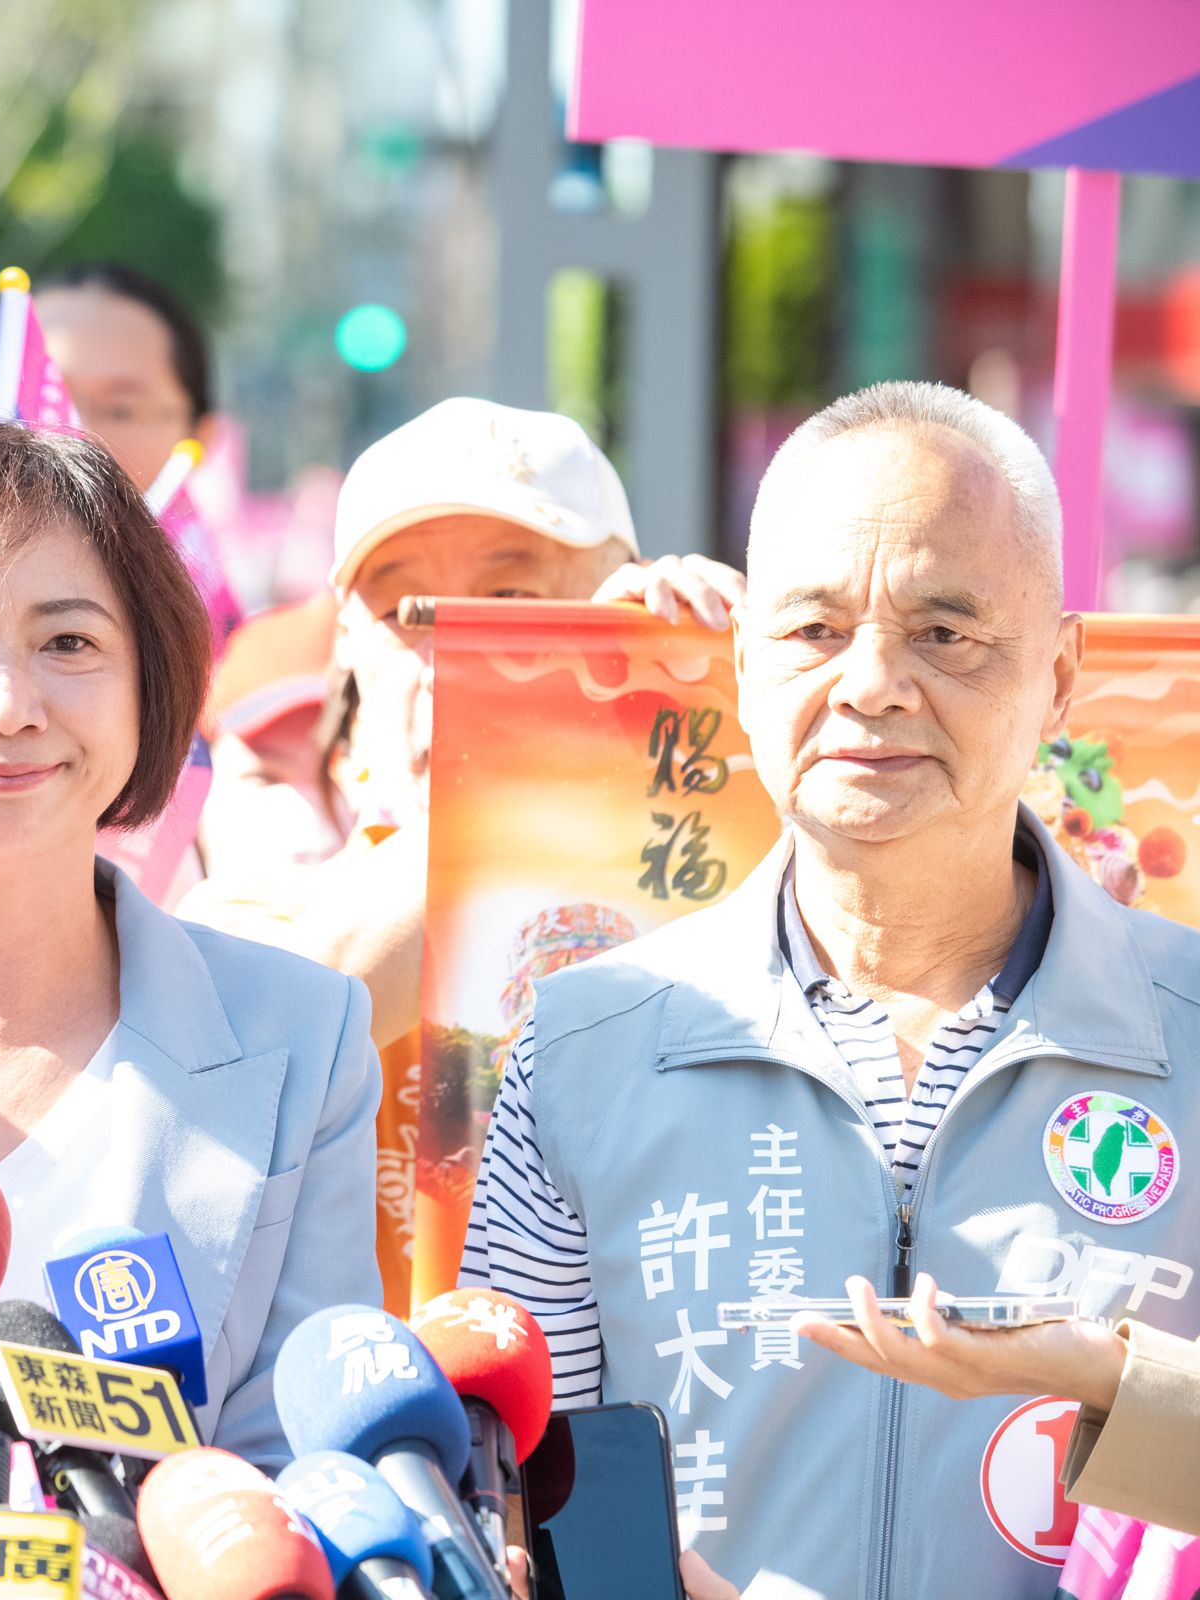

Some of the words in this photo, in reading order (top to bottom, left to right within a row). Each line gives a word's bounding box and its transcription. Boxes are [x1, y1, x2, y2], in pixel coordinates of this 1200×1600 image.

[1091, 1183, 1164, 1219] PROGREIVE
[1156, 1152, 1174, 1194] PARTY
[747, 1123, 806, 1371] 主任委員
[995, 1234, 1195, 1312] DPP
[79, 1309, 181, 1358] NTD
[11, 1353, 93, 1396] 東森
[96, 1371, 188, 1444] 51
[27, 1391, 107, 1434] 新聞
